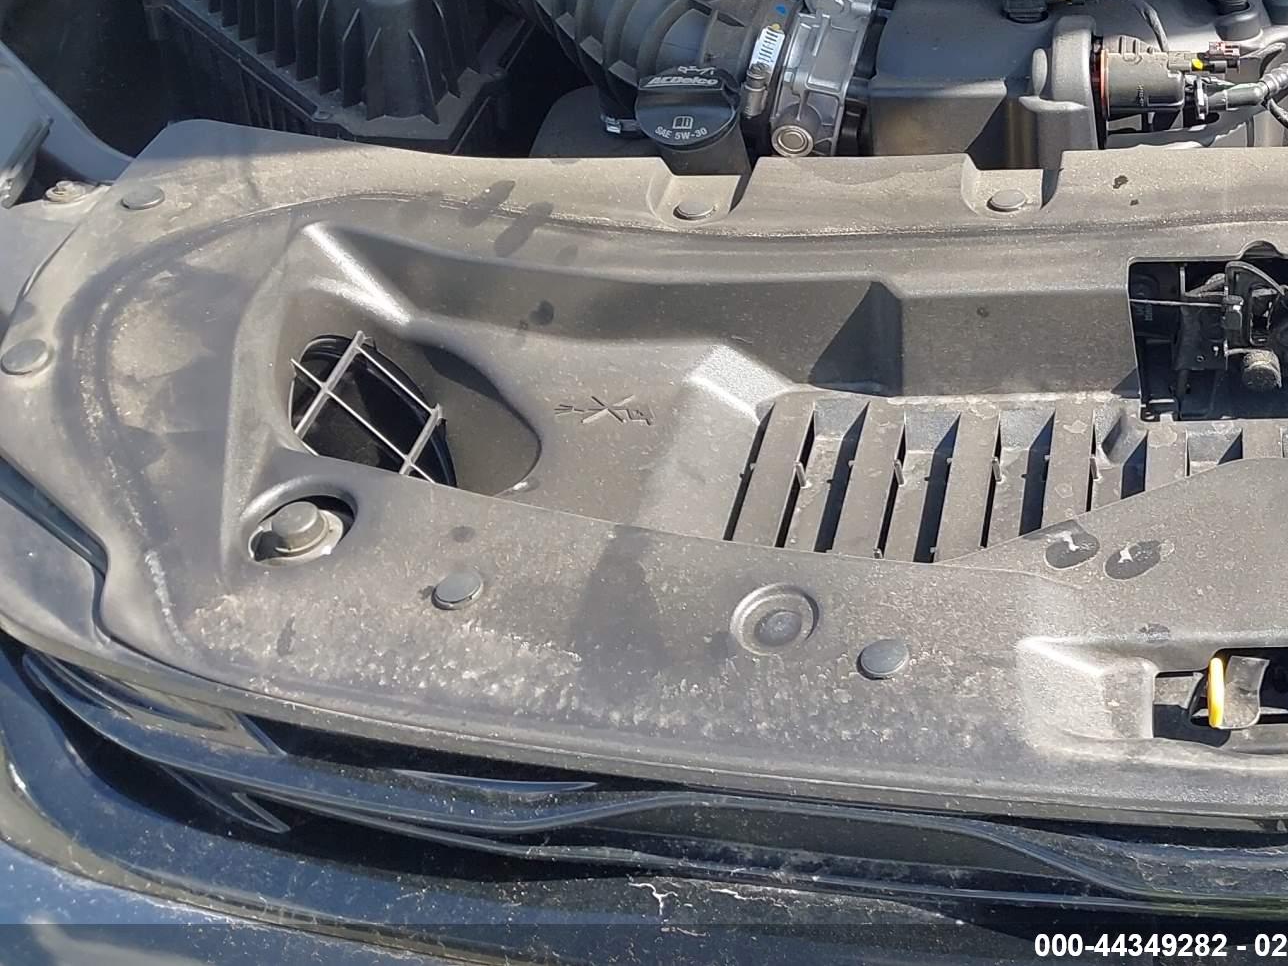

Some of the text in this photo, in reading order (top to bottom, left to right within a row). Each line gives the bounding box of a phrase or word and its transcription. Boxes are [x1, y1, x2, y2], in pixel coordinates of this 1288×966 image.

[646, 76, 719, 87] ACDelco
[655, 126, 708, 140] SAE 5W-30
